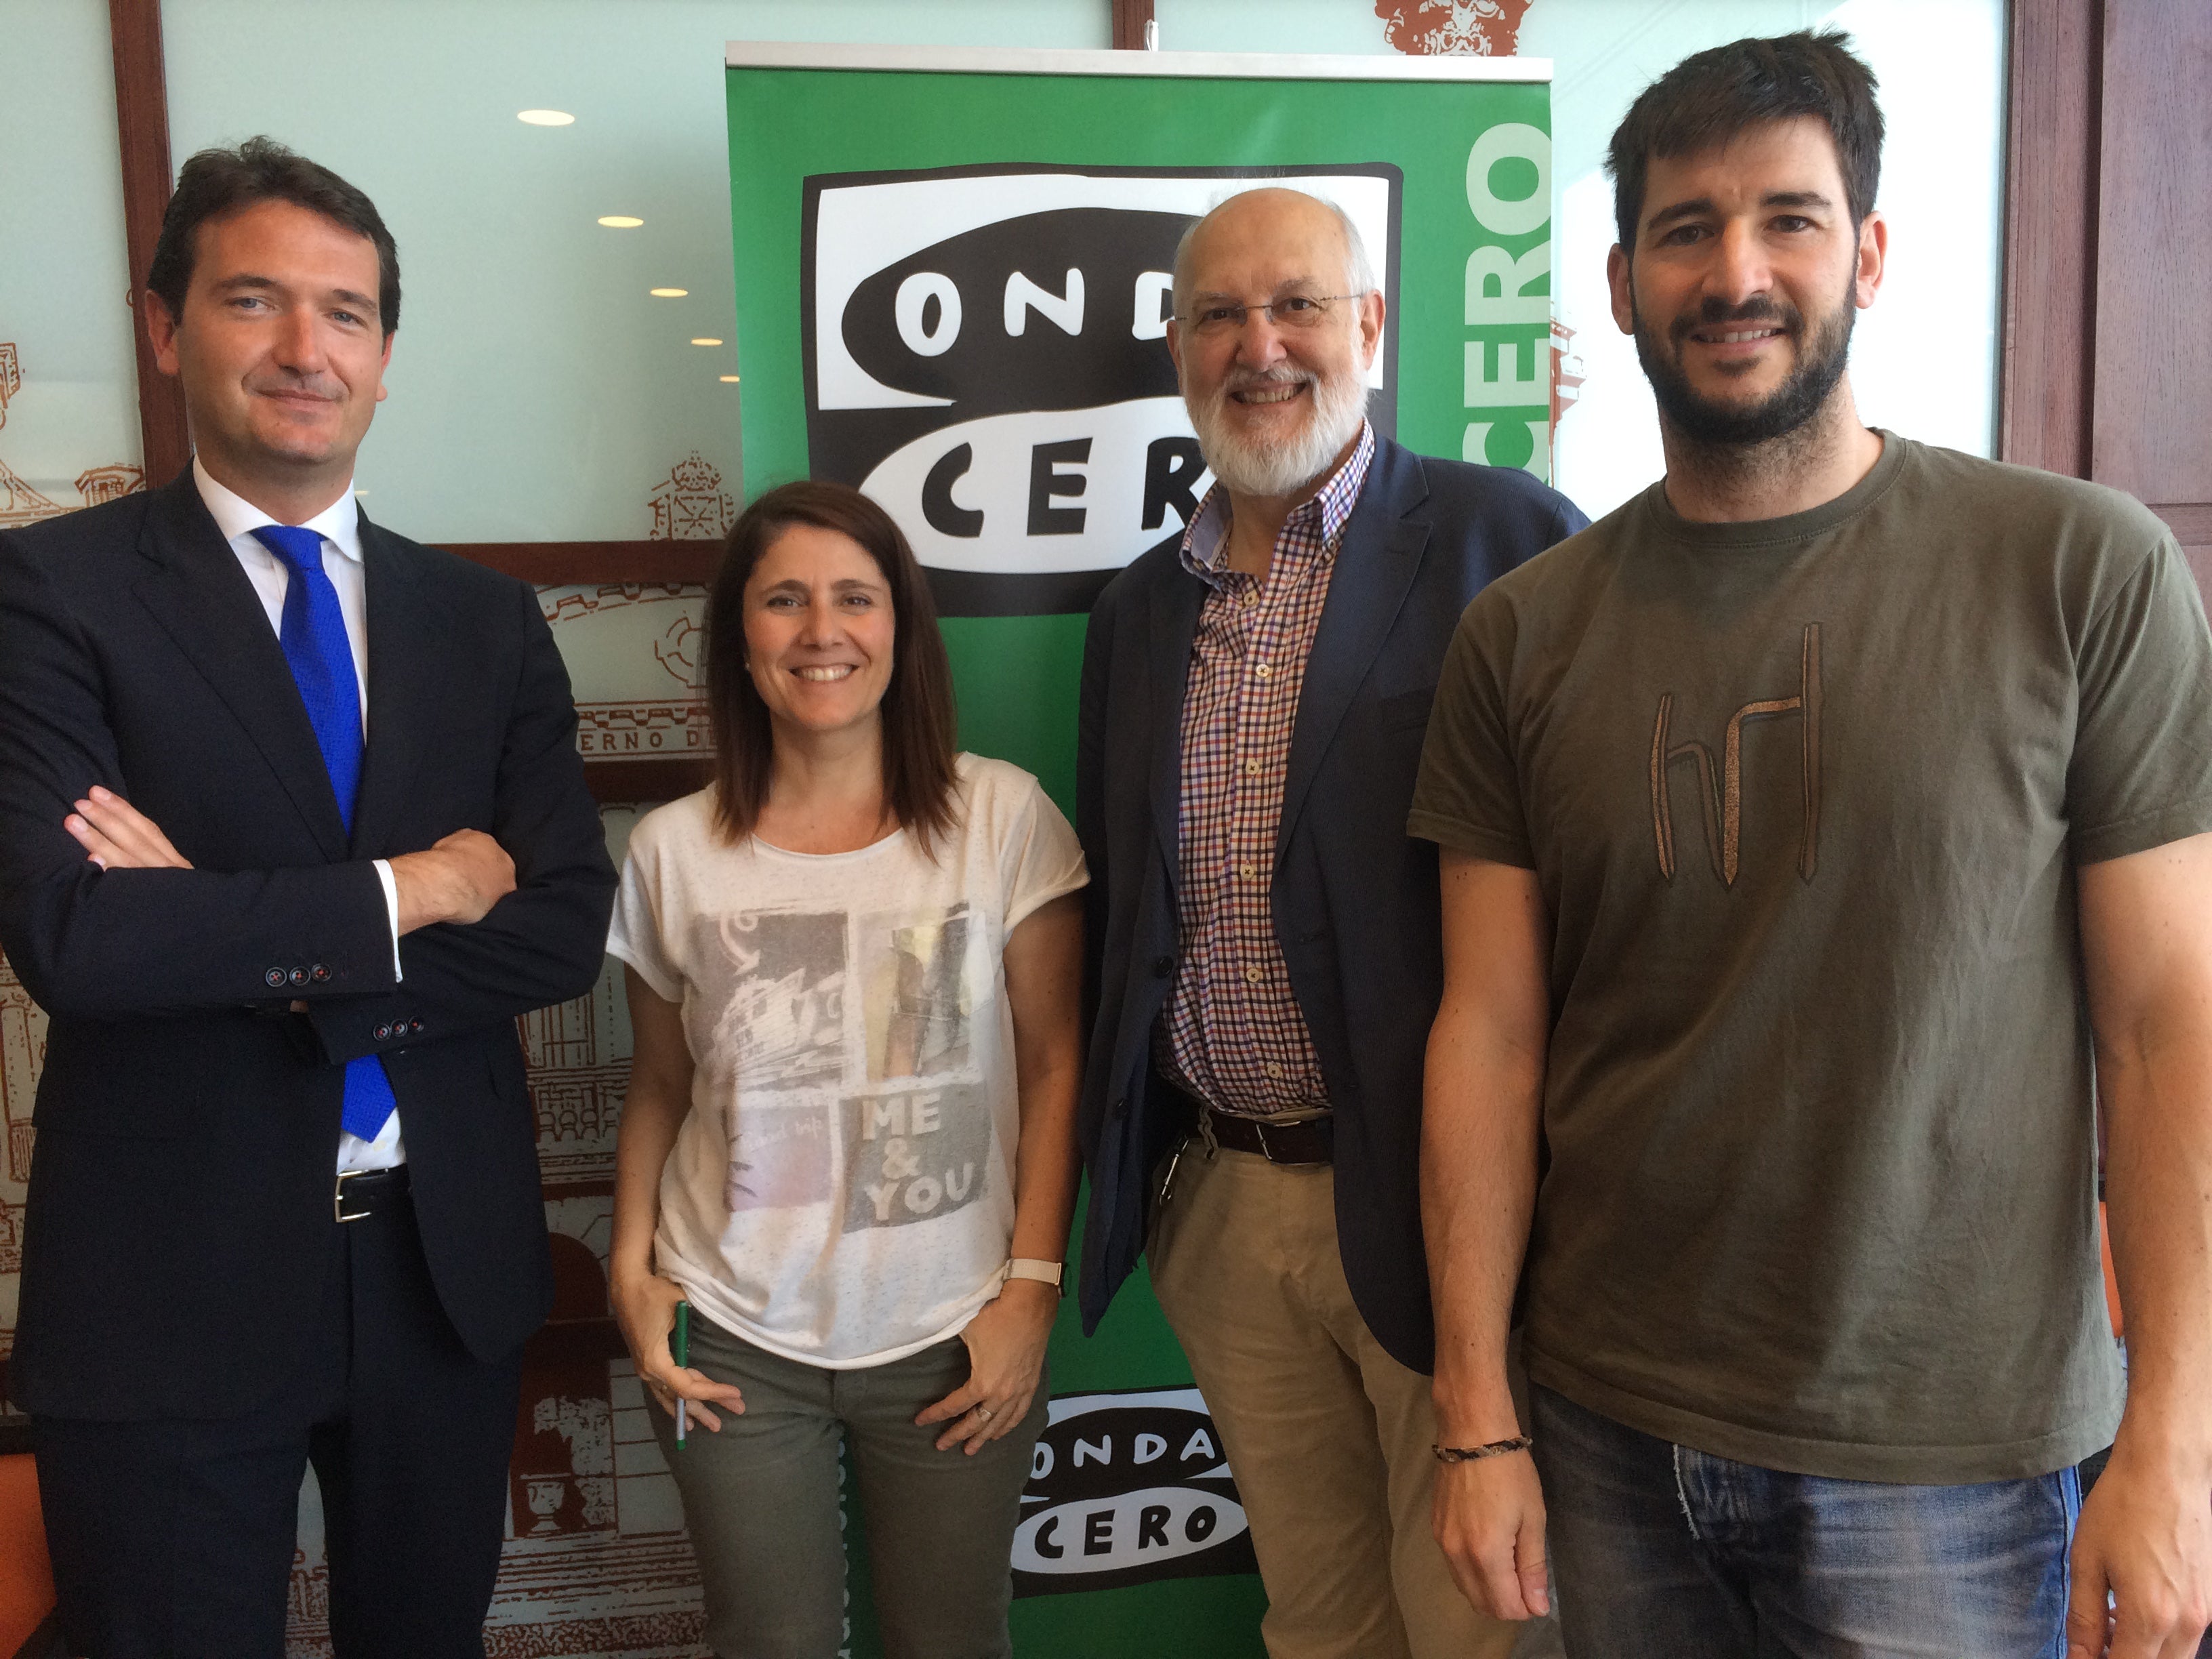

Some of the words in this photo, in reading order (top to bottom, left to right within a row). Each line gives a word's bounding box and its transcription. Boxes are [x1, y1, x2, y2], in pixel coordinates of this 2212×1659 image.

[895, 267, 1174, 356] OND
[922, 436, 1207, 538] CER
[581, 732, 663, 750] ERNO
[862, 1092, 941, 1140] ME
[882, 1137, 922, 1181] &
[864, 1162, 974, 1221] YOU
[1031, 1428, 1216, 1479] ONDA
[1033, 1504, 1217, 1559] CERO
